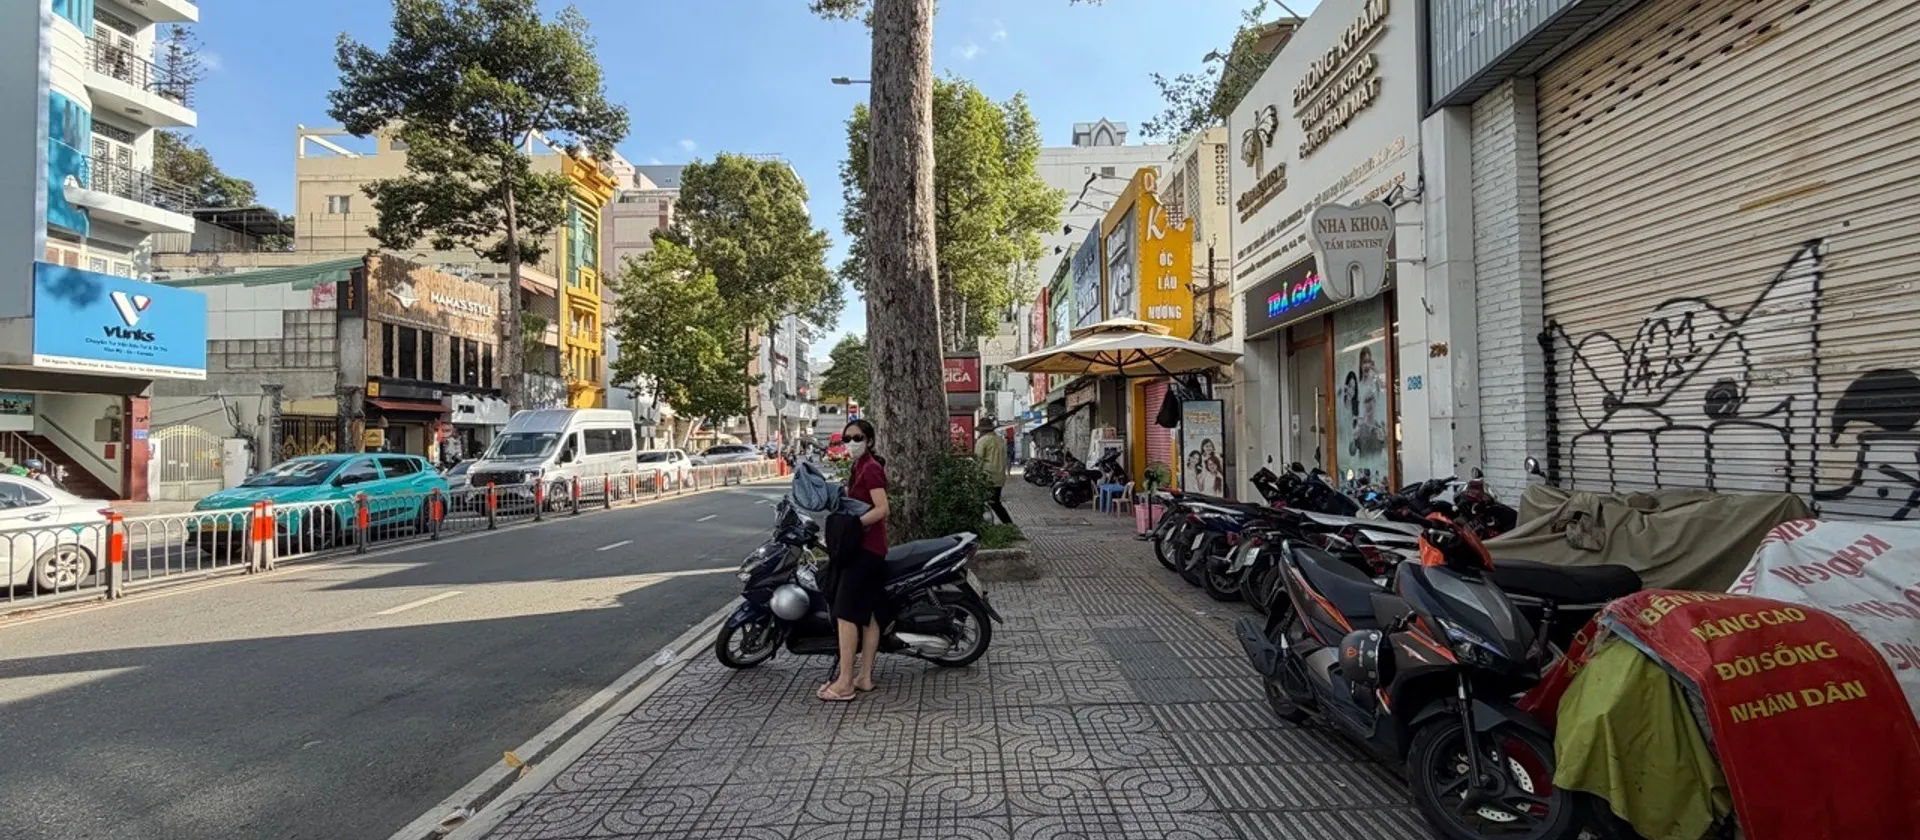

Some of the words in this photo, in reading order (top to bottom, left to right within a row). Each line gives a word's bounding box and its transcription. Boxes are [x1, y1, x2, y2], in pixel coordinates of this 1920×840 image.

[1291, 46, 1336, 107] PHÒNG
[1301, 86, 1338, 131] CHUYÊN
[1340, 53, 1376, 96] KHOA
[1317, 219, 1347, 234] NHA
[1350, 215, 1389, 232] KHOA
[1345, 238, 1384, 250] DENTIST
[468, 301, 493, 316] STYLE
[1267, 281, 1289, 317] TRẢ
[1758, 607, 1807, 626] CAO
[1761, 641, 1839, 670] SỐNG
[1730, 692, 1798, 724] NHÂN
[1798, 680, 1867, 707] DÂN
